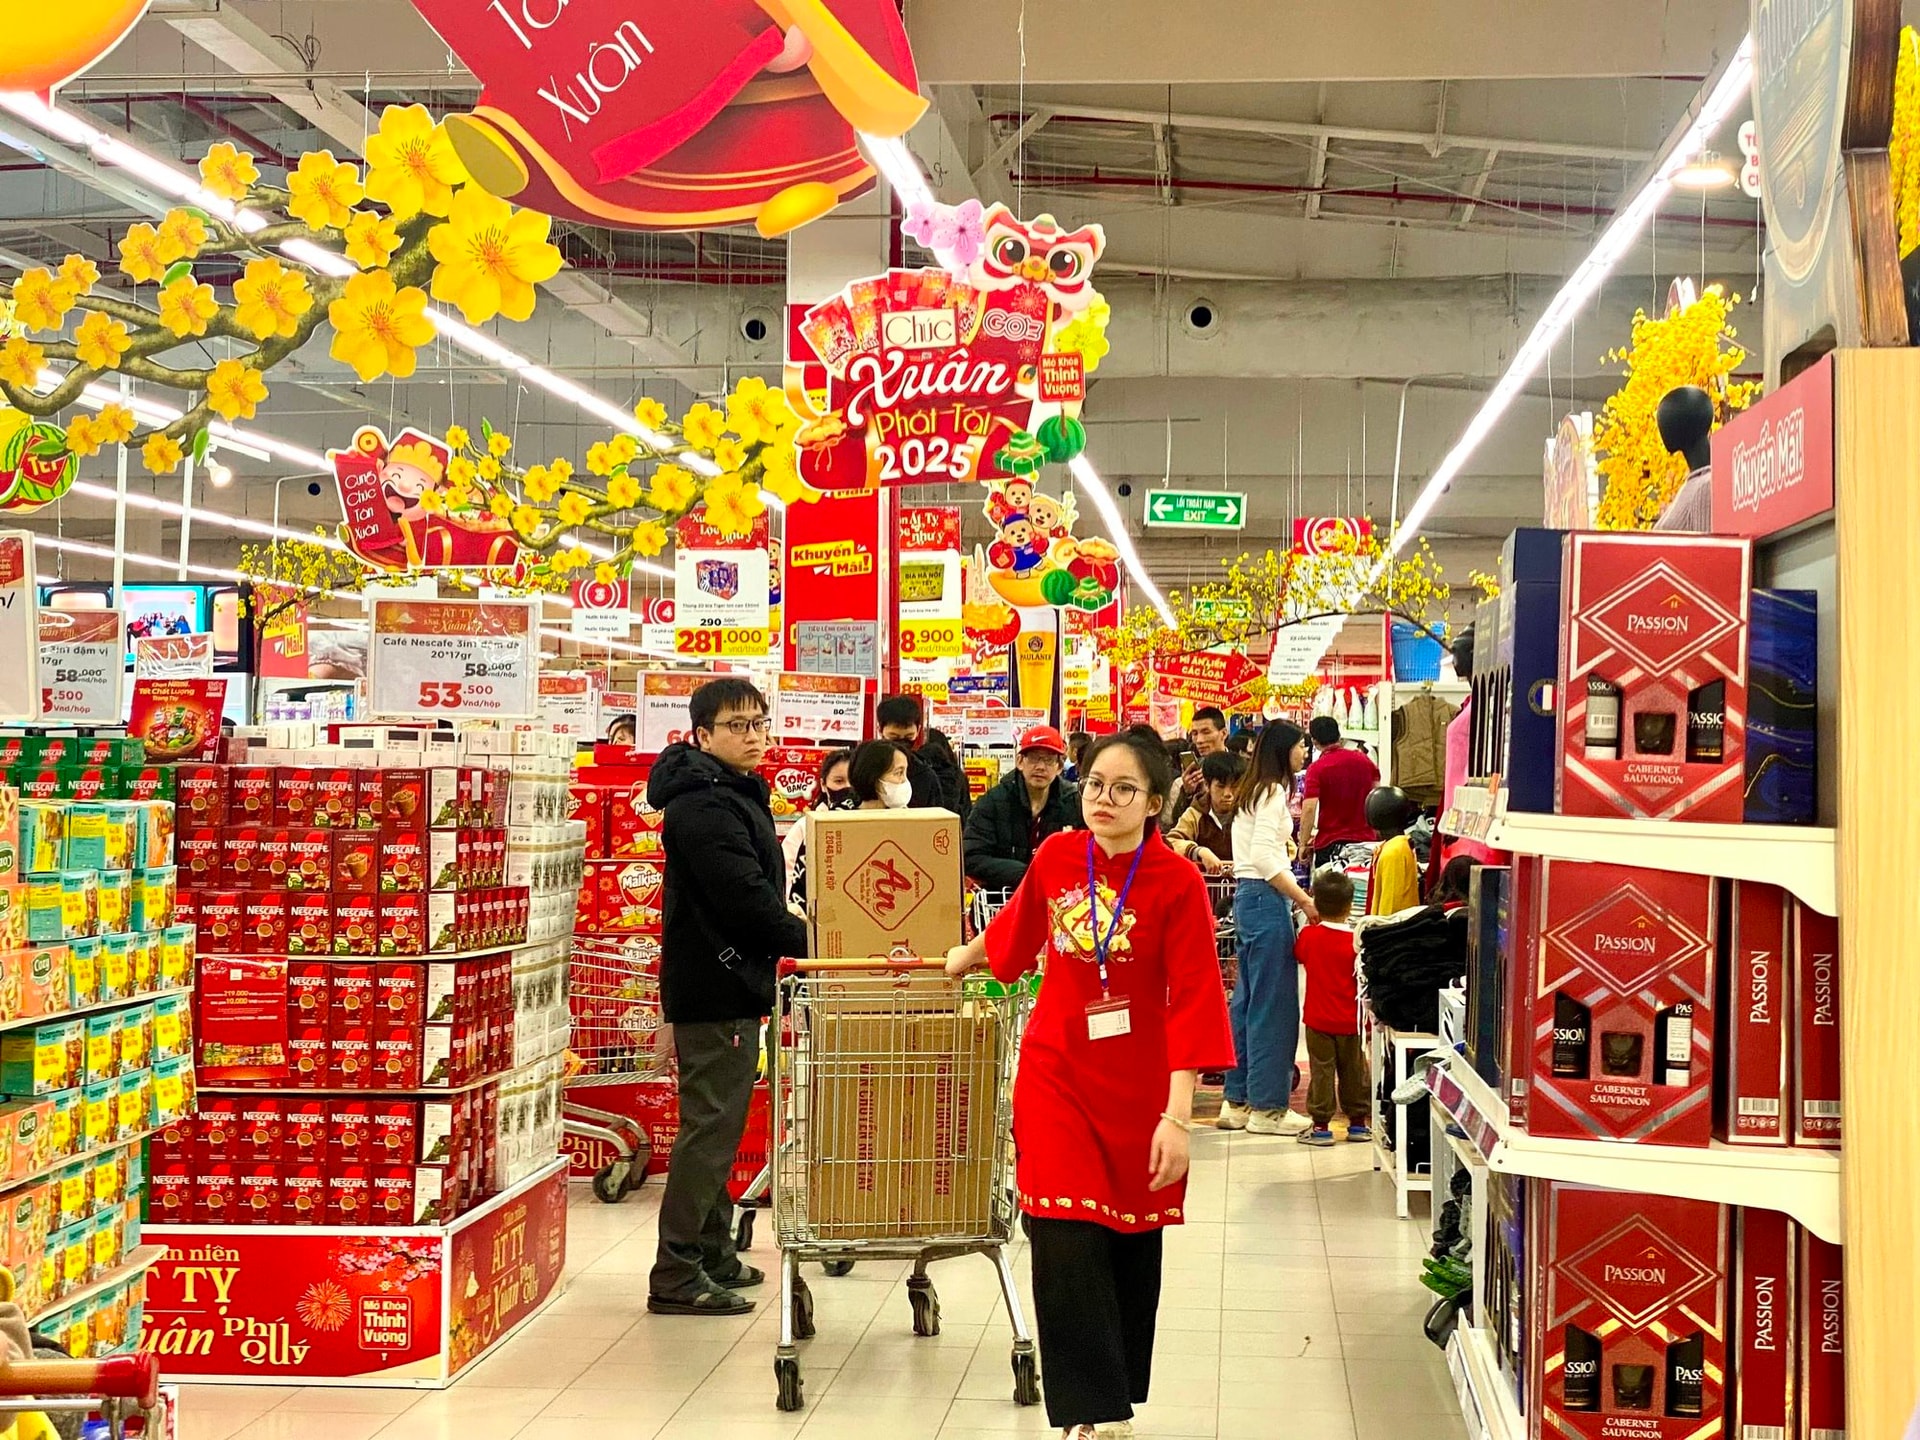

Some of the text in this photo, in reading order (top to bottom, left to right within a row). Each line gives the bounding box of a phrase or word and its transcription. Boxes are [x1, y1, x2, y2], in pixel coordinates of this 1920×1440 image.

[536, 21, 655, 143] Xuân
[885, 312, 952, 346] Chúc
[847, 348, 1011, 426] Xuân
[875, 403, 992, 442] Phát Tài
[873, 437, 975, 480] 2025
[1733, 423, 1775, 507] Khuyến
[1183, 509, 1207, 522] EXIT
[794, 543, 851, 563] Khuyến
[662, 604, 673, 618] 4
[1627, 614, 1689, 632] PASSION
[553, 724, 569, 734] 56
[784, 716, 802, 728] 51
[1623, 772, 1684, 785] SAUVIGNON
[1627, 764, 1680, 775] CABERNET
[869, 858, 913, 918] An
[1594, 933, 1656, 954] PASSION
[1750, 950, 1770, 1024] PASSION
[1813, 952, 1833, 1026] PASSION
[1594, 1084, 1647, 1096] CABERNET
[1589, 1094, 1651, 1107] SAUVIGNON
[190, 1244, 240, 1262] niên
[1604, 1264, 1666, 1286] PASSION
[172, 1267, 240, 1316] TỴ
[364, 1312, 407, 1331] Thịnh
[1754, 1275, 1775, 1351] PASSION
[1821, 1279, 1841, 1354] PASSION
[364, 1330, 407, 1346] Vượng
[1605, 1417, 1659, 1429] CABERNET
[1601, 1427, 1663, 1440] SAUVIGNON
